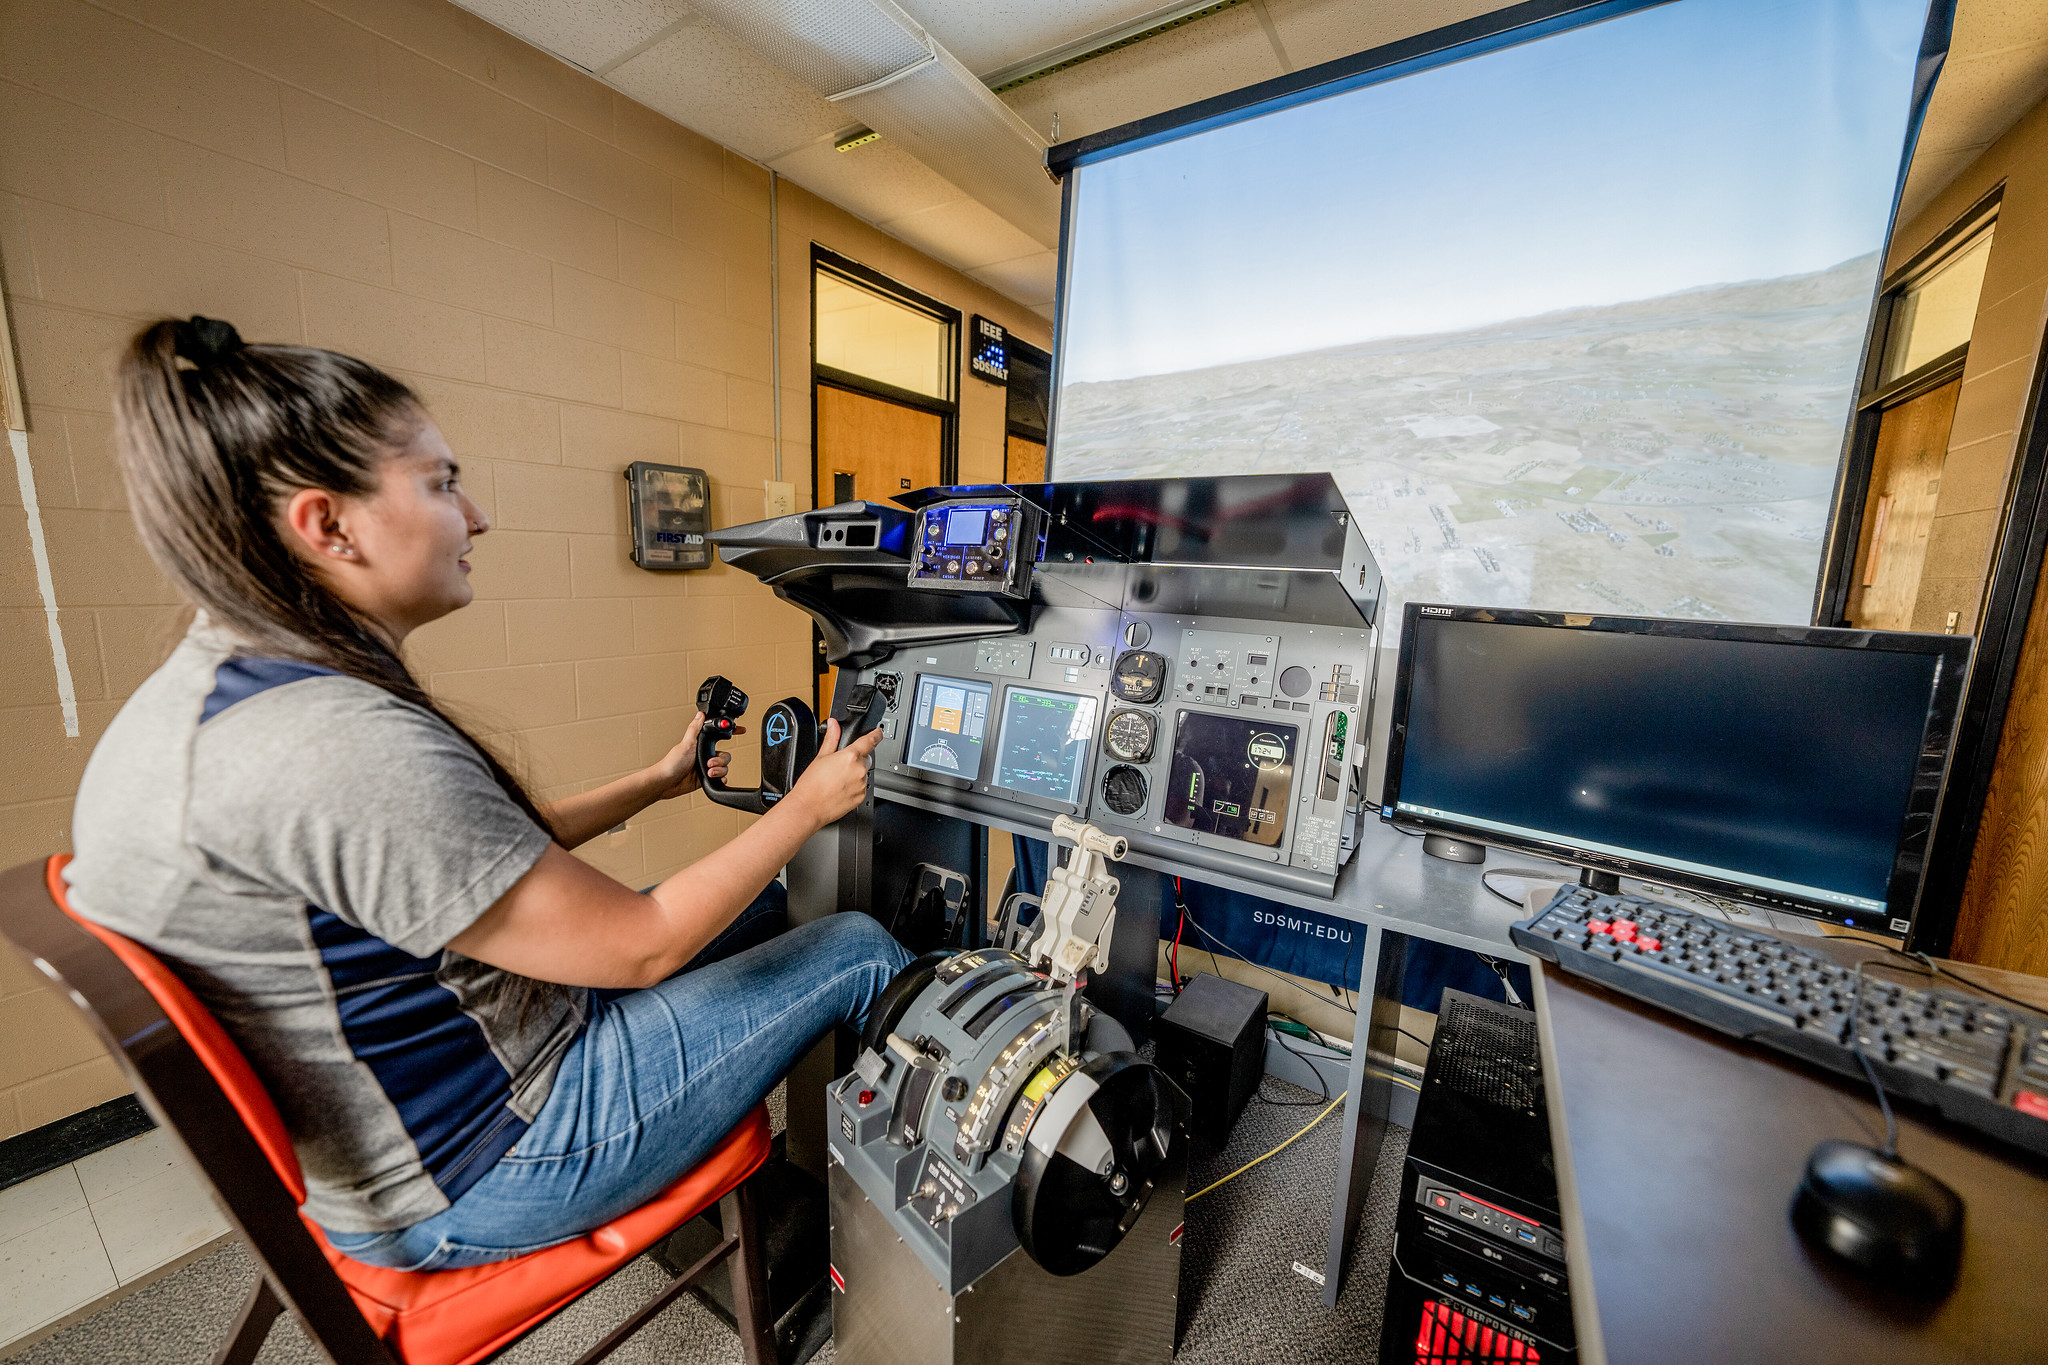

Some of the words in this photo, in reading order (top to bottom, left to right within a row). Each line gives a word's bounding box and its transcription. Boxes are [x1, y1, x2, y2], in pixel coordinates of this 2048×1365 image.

[980, 320, 1002, 341] IEEE
[972, 357, 1008, 380] SDSM&T
[656, 532, 686, 543] FIRST
[684, 534, 704, 544] AID
[1253, 911, 1351, 943] SDSMT.EDU
[976, 1085, 987, 1098] 25
[1453, 1302, 1536, 1347] CYBERPOWERPC
